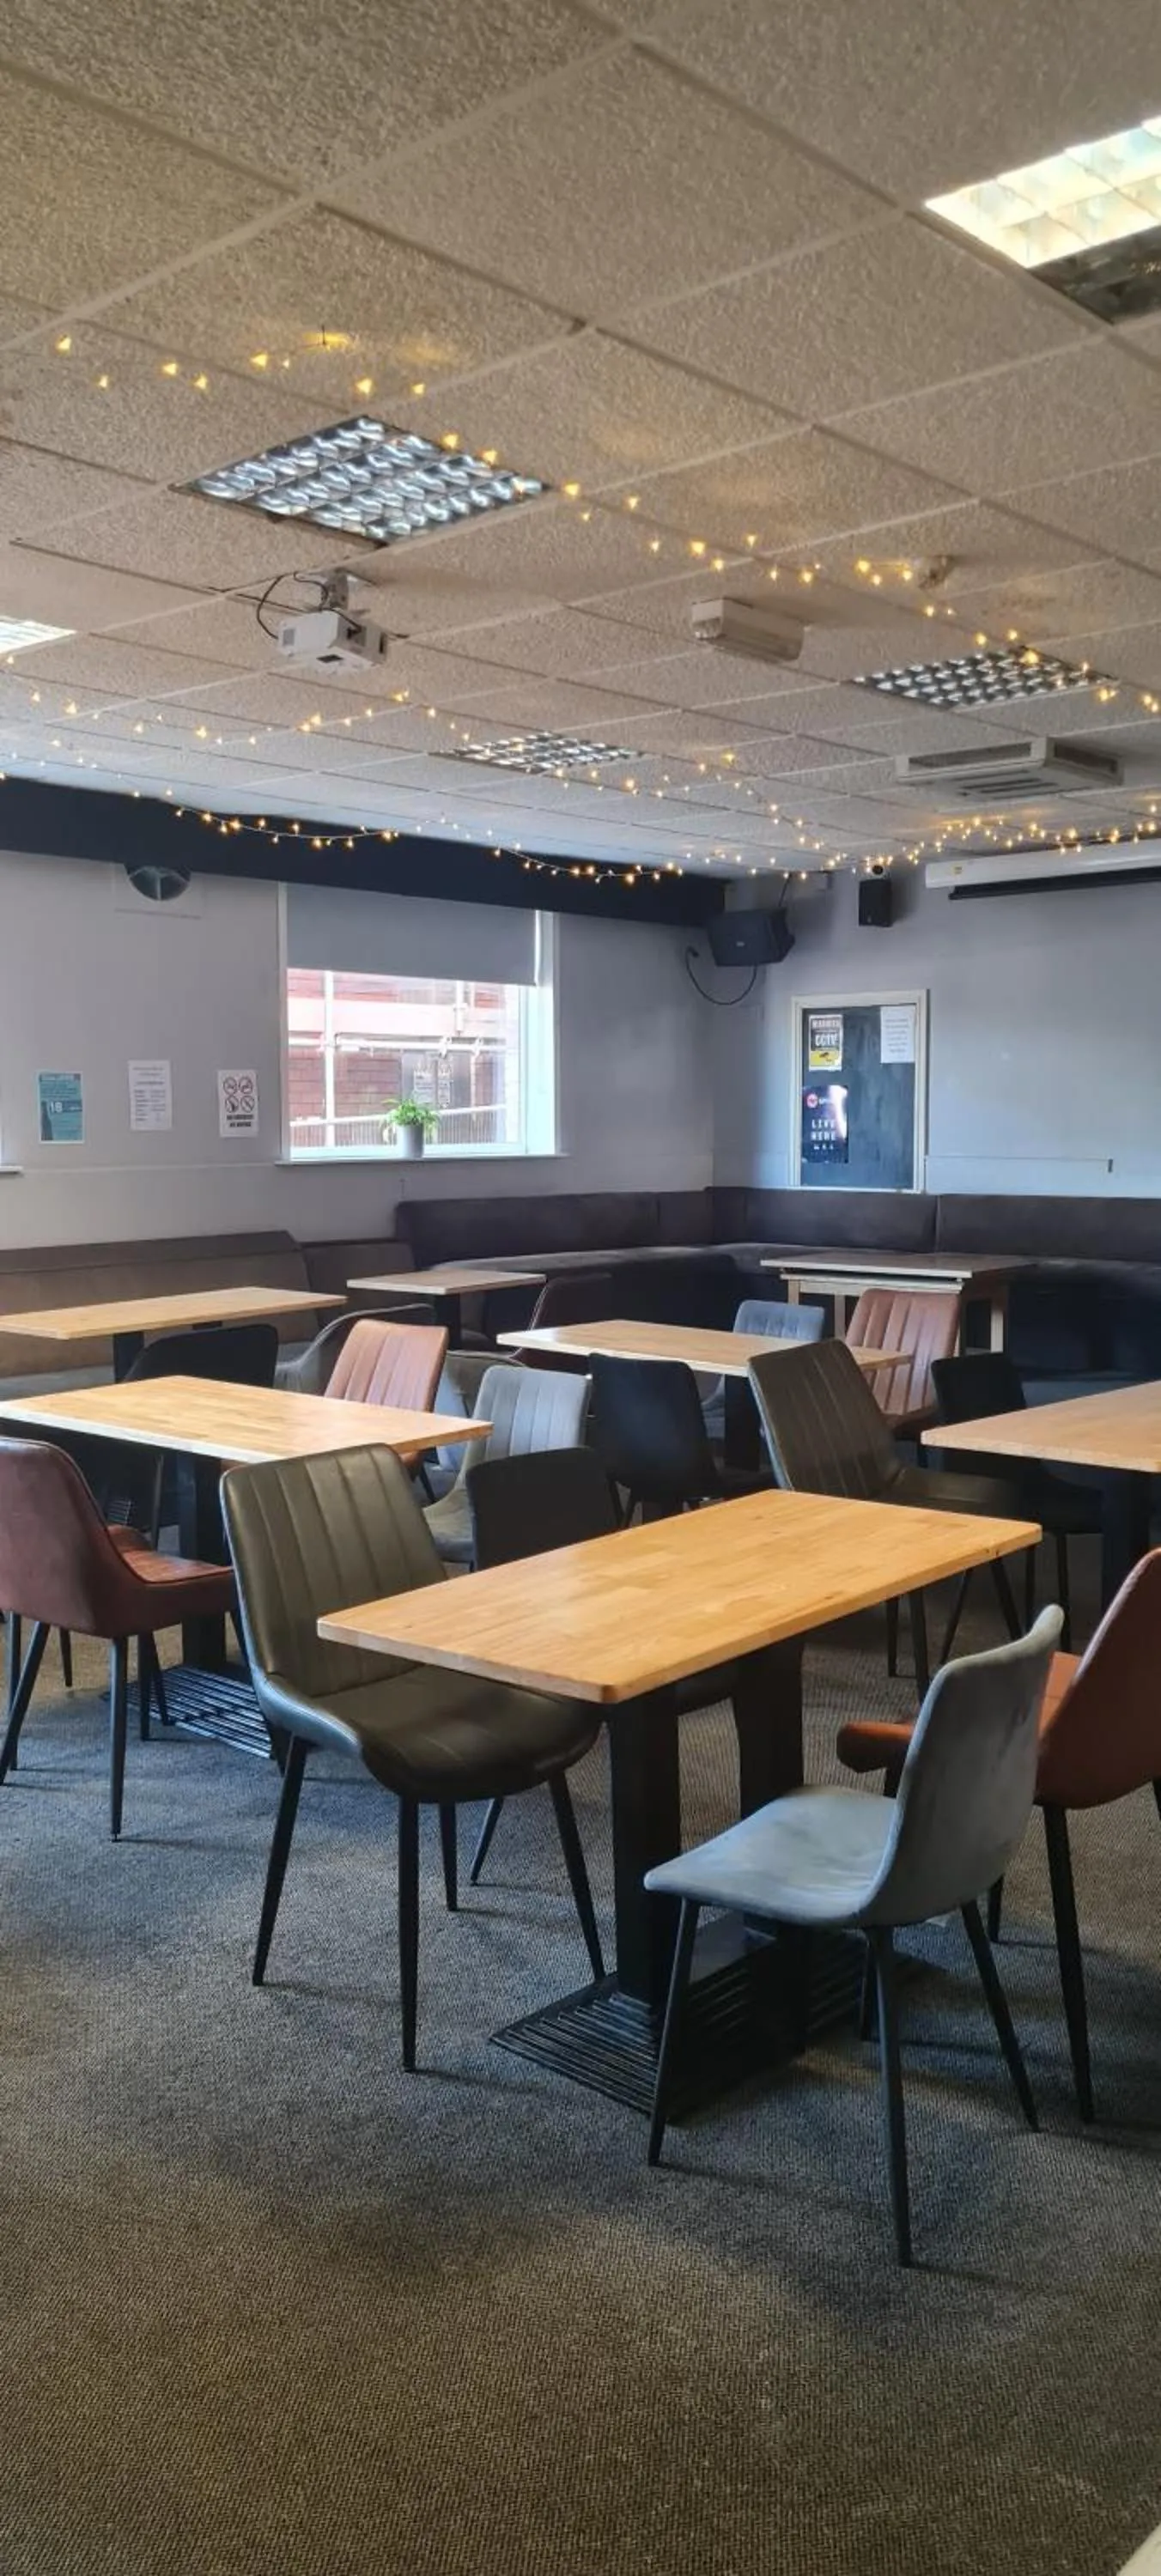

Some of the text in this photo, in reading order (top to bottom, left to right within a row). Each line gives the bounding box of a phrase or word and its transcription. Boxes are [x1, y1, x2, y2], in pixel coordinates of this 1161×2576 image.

[815, 1033, 838, 1046] CCTV
[51, 1102, 63, 1114] 18
[811, 1119, 836, 1129] LIVE
